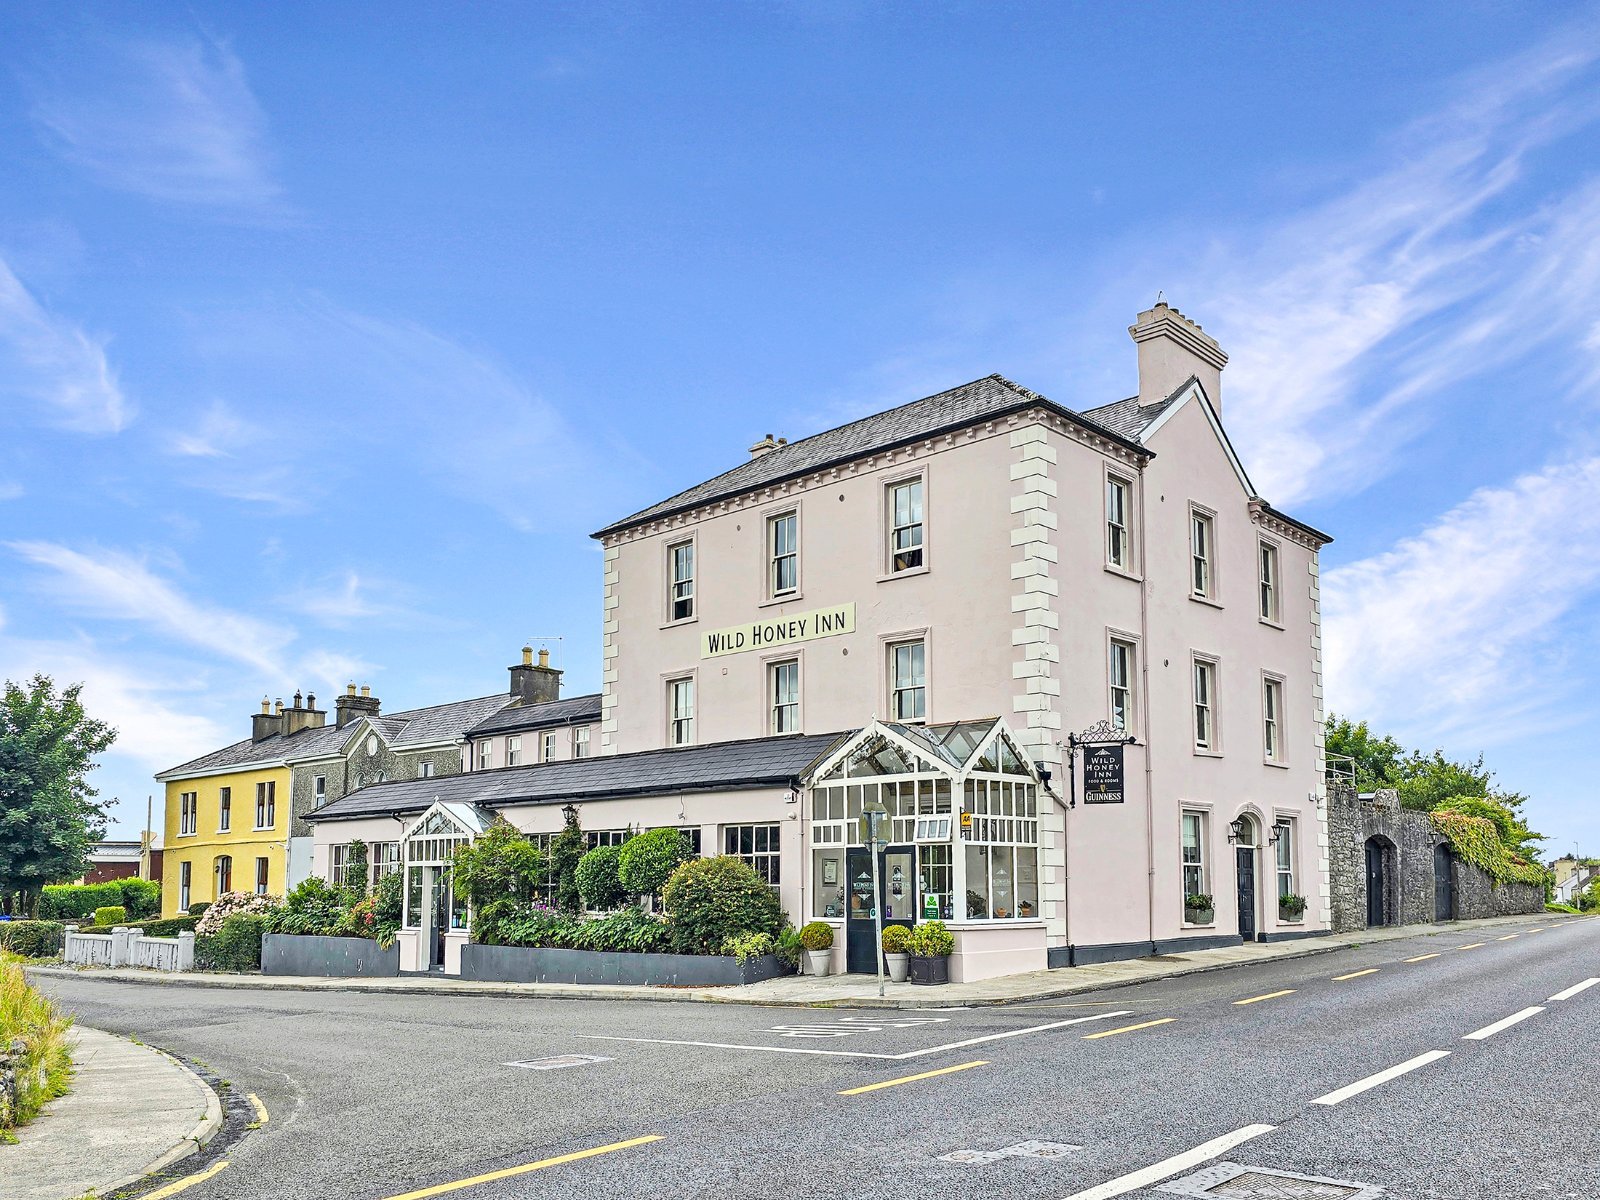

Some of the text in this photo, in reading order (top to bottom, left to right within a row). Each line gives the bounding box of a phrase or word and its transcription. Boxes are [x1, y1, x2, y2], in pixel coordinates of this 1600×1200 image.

[709, 611, 845, 653] WILD HONEY INN
[1086, 791, 1121, 801] GUINNESS
[963, 815, 971, 823] AA
